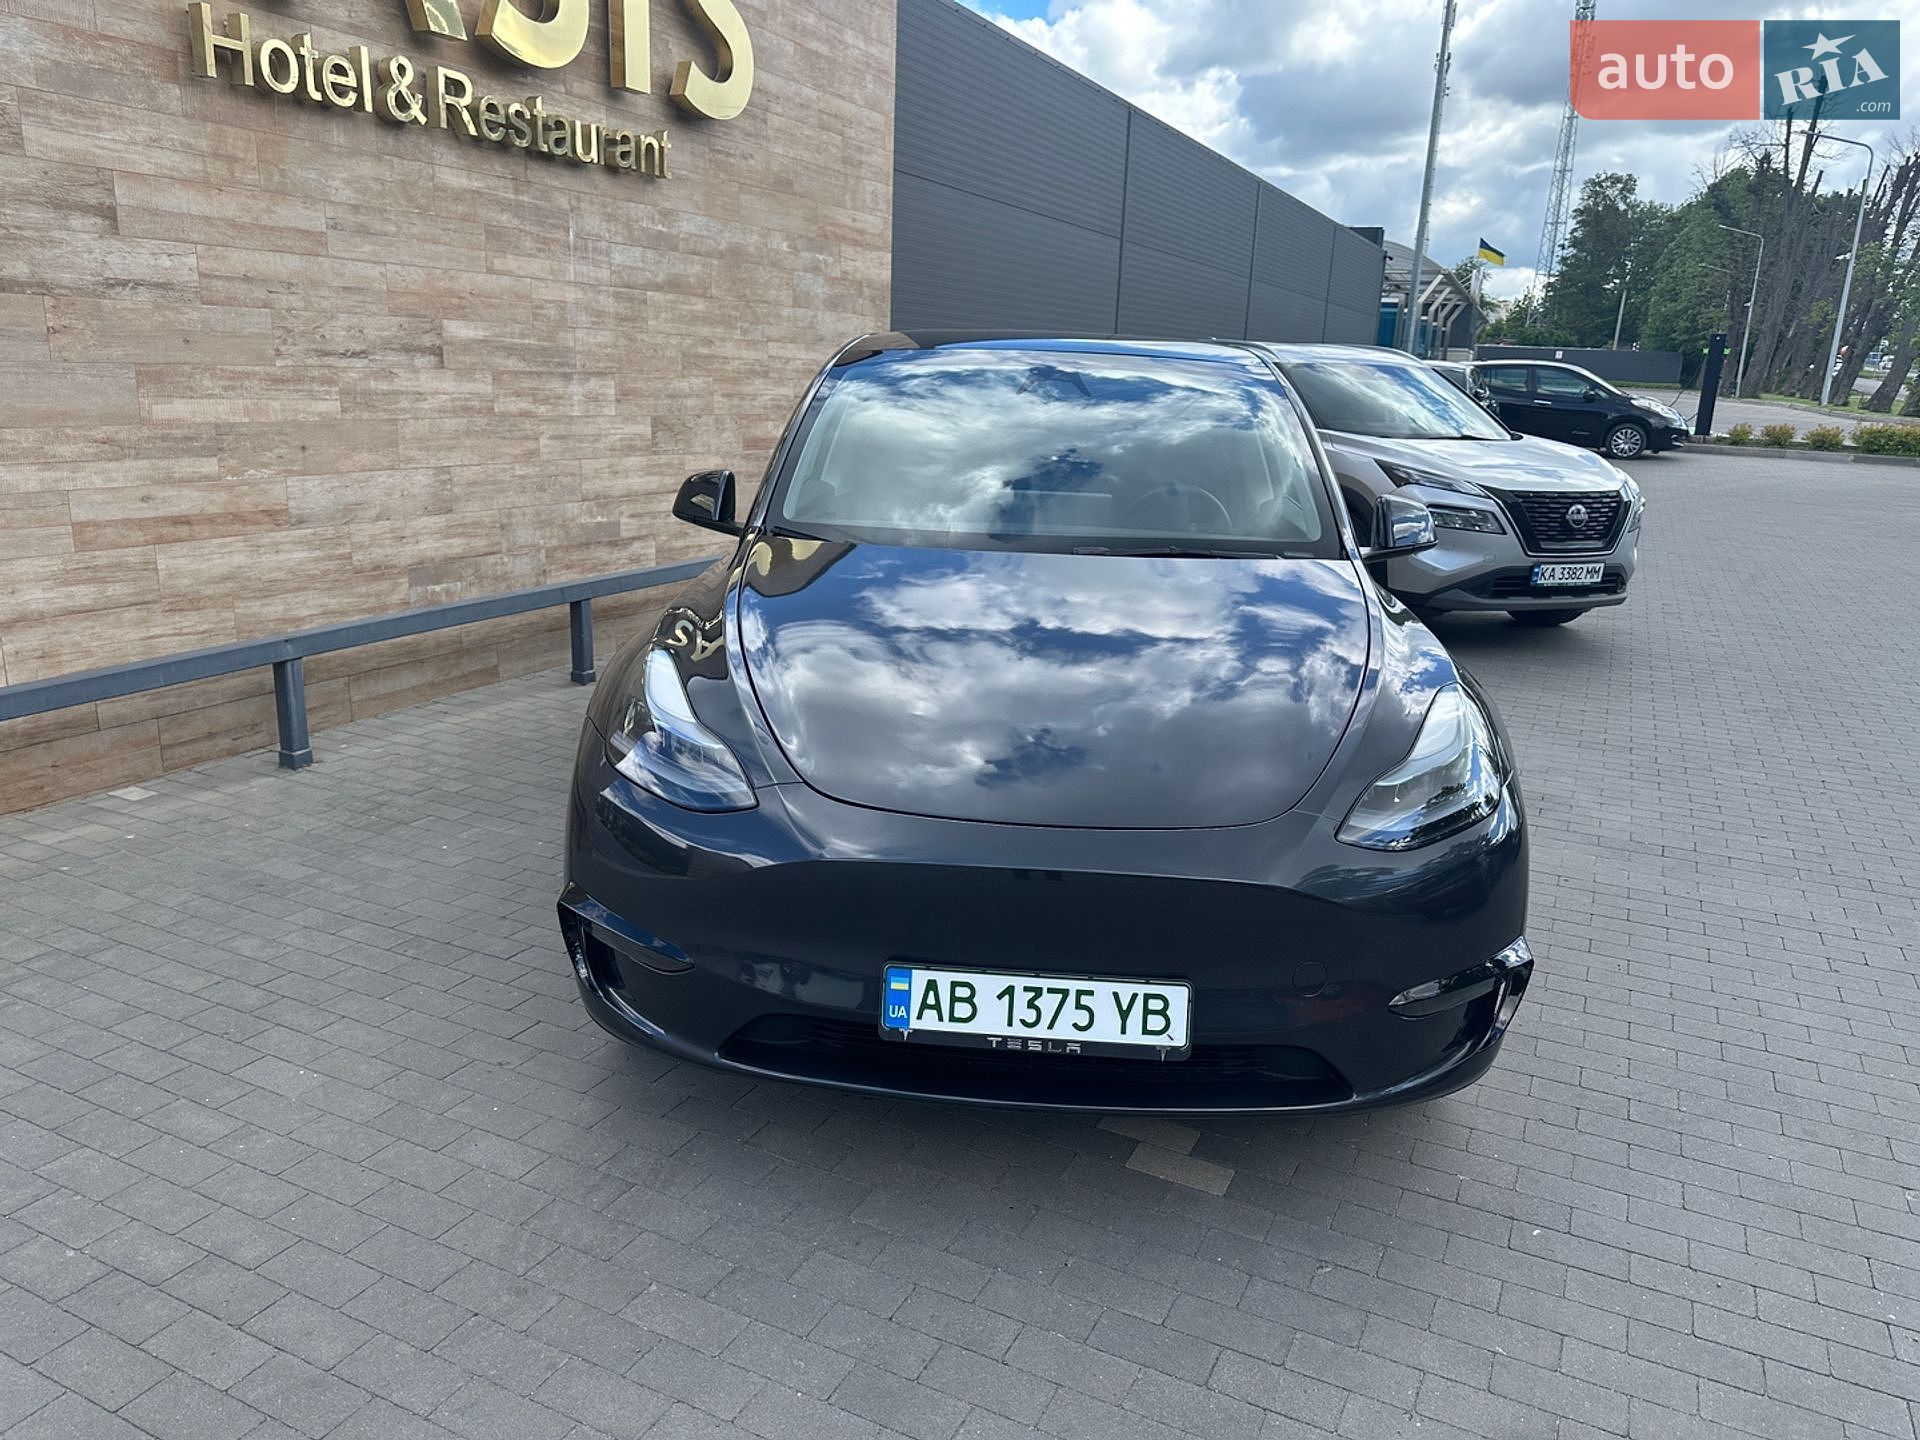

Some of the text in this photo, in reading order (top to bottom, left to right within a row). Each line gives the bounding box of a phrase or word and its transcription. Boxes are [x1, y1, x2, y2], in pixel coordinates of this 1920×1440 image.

[190, 2, 672, 179] Hotel & Restaurant
[1540, 565, 1601, 581] KA 3382 MM
[889, 1004, 907, 1019] UA
[916, 979, 1171, 1036] AB 1375 YB
[987, 1037, 1081, 1054] TESLA
